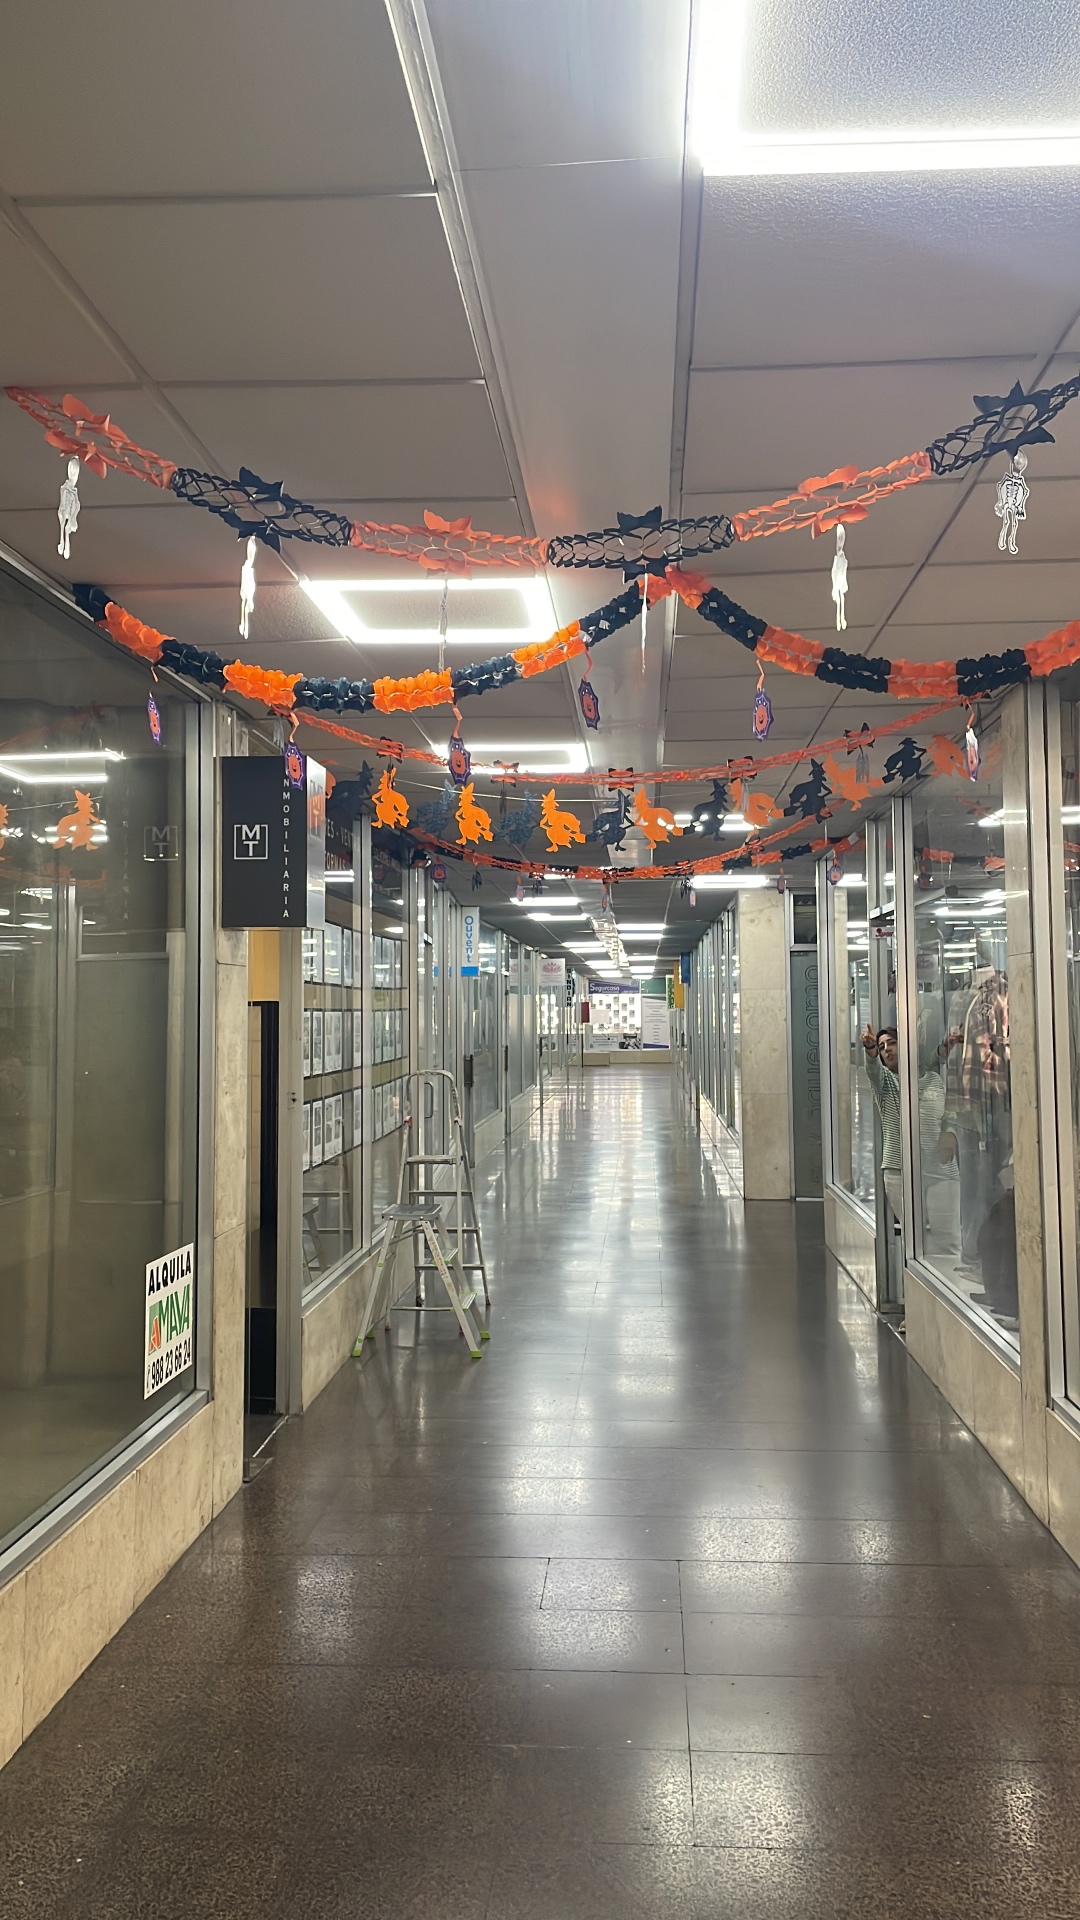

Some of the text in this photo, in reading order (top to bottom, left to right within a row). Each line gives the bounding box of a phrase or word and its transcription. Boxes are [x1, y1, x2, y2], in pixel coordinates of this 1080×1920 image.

[464, 915, 474, 963] Ouvent
[148, 1251, 192, 1296] ALQUILA
[151, 1337, 191, 1390] 988 23 66 24
